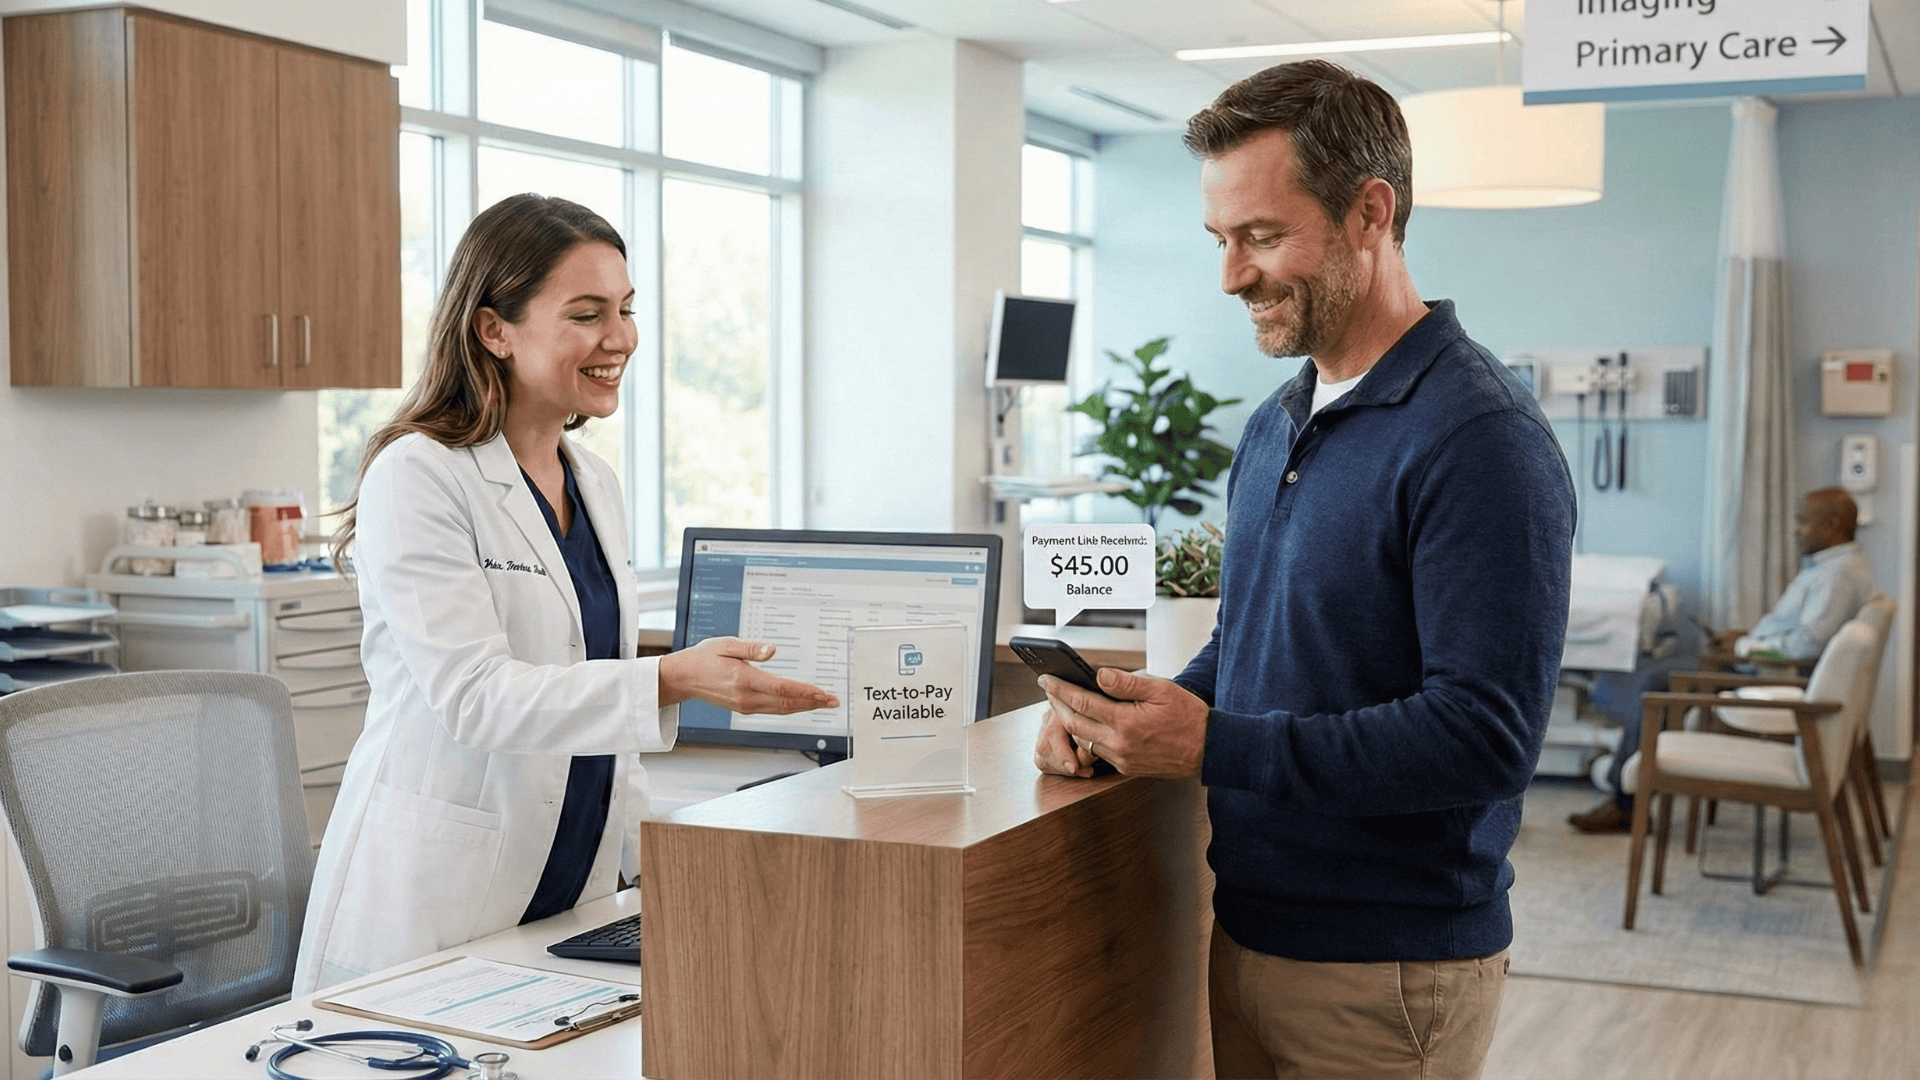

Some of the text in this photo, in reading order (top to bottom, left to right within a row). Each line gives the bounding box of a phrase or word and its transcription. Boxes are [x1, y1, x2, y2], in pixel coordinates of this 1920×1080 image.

[1577, 31, 1797, 70] Primary Care
[864, 684, 953, 702] Text-to-Pay
